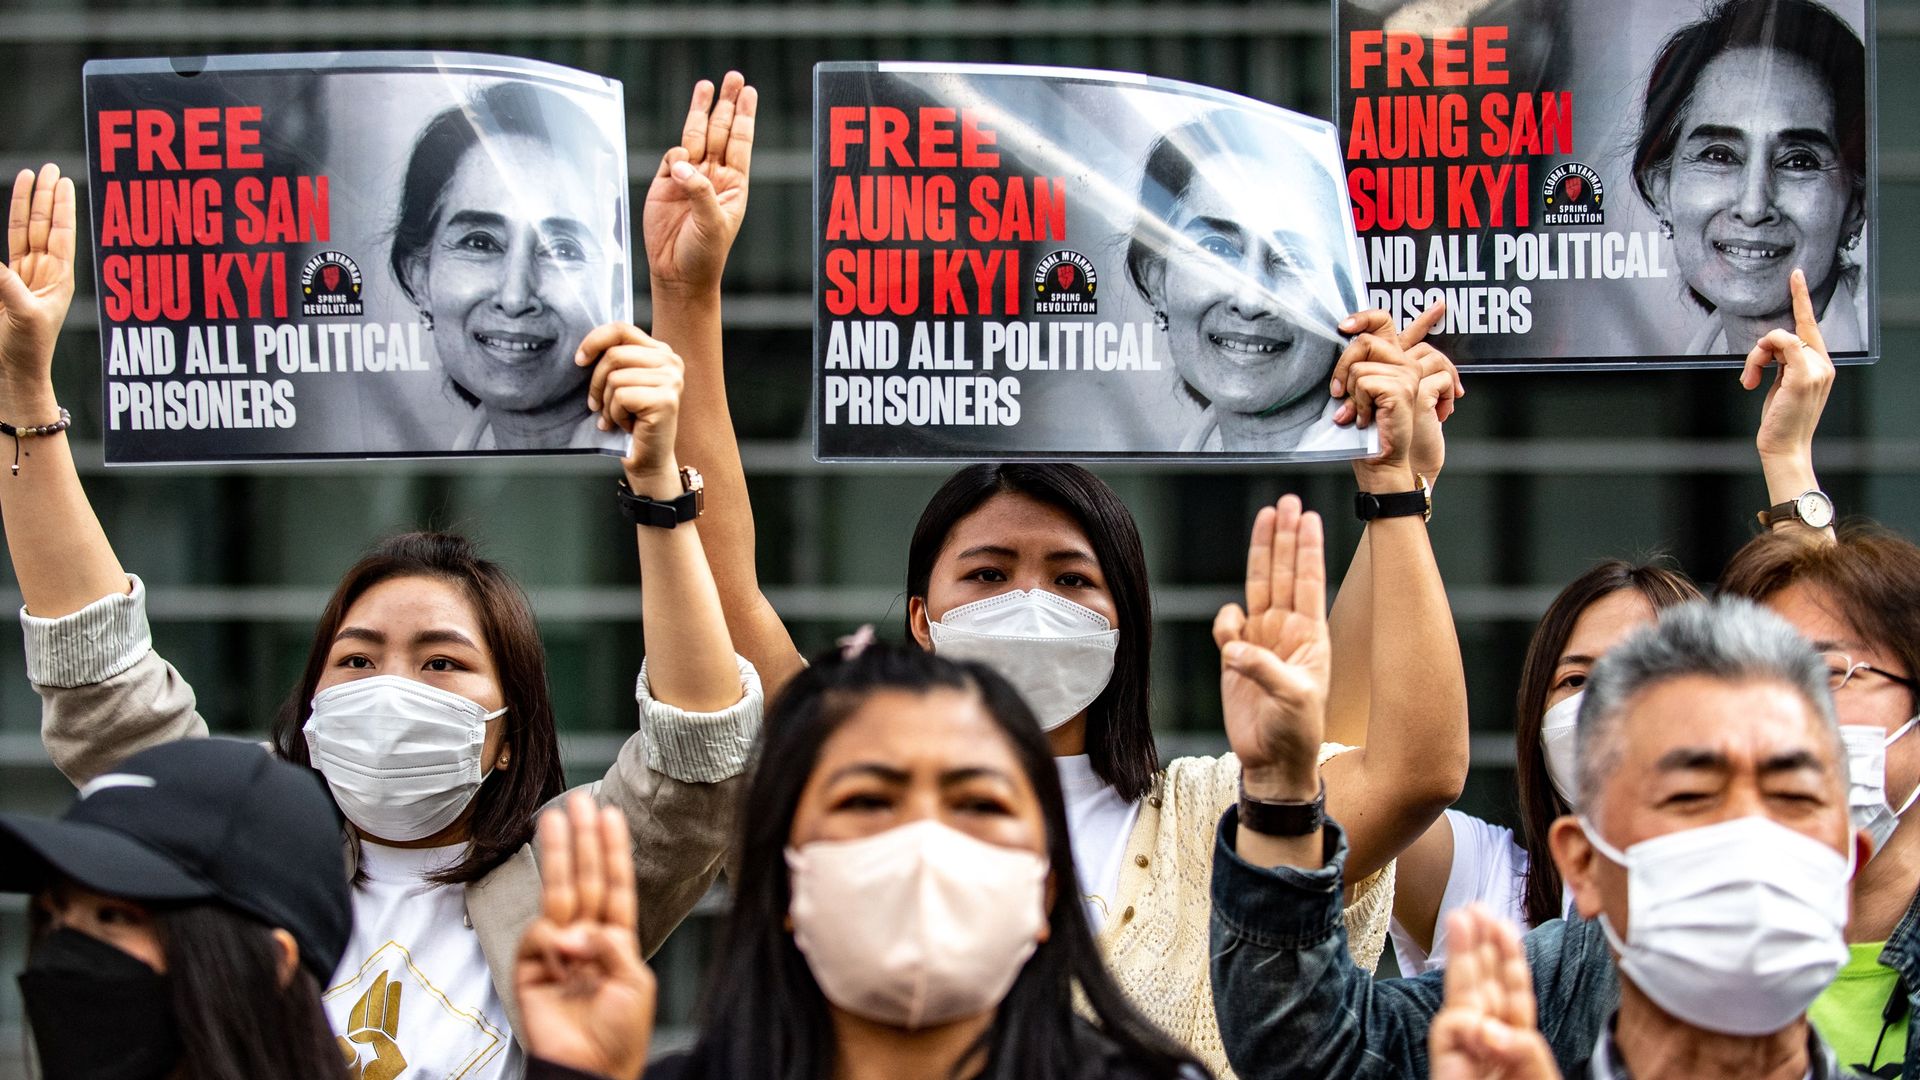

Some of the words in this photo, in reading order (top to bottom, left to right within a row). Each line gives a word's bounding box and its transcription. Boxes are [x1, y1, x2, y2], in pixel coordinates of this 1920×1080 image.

[1349, 25, 1509, 89] FREE
[98, 106, 264, 173] FREE
[829, 106, 1000, 168] FREE
[1347, 94, 1469, 160] AUNG
[1480, 91, 1573, 158] SAN
[1348, 165, 1435, 232] SUU
[1447, 164, 1529, 228] KYI
[1544, 166, 1567, 195] GLOBAL
[1569, 164, 1603, 194] MYANMAR
[101, 178, 224, 248] AUNG
[235, 176, 331, 246] SAN
[825, 175, 956, 242] AUNG
[968, 175, 1066, 242] SAN
[1545, 213, 1602, 224] REVOLUTION
[1559, 204, 1588, 213] SPRING
[825, 248, 920, 316] SUU
[933, 249, 1020, 316] KYI
[1035, 254, 1060, 283] GLOBAL
[1062, 251, 1096, 283] MYANMAR
[1424, 234, 1486, 282] ALL
[1494, 231, 1668, 281] POLITICAL
[103, 252, 191, 322] SUU
[203, 252, 288, 319] KYI
[1036, 302, 1095, 313] REVOLUTION
[1051, 293, 1081, 302] SPRING
[1369, 286, 1532, 335] ISONERS
[108, 327, 176, 376] AND
[185, 325, 248, 375] ALL
[254, 323, 430, 373] POLITICAL
[824, 321, 899, 370] AND
[908, 321, 973, 370] ALL
[982, 321, 1162, 371] POLITICAL
[109, 380, 297, 430] PRISONERS
[825, 376, 1021, 426] PRISONERS
